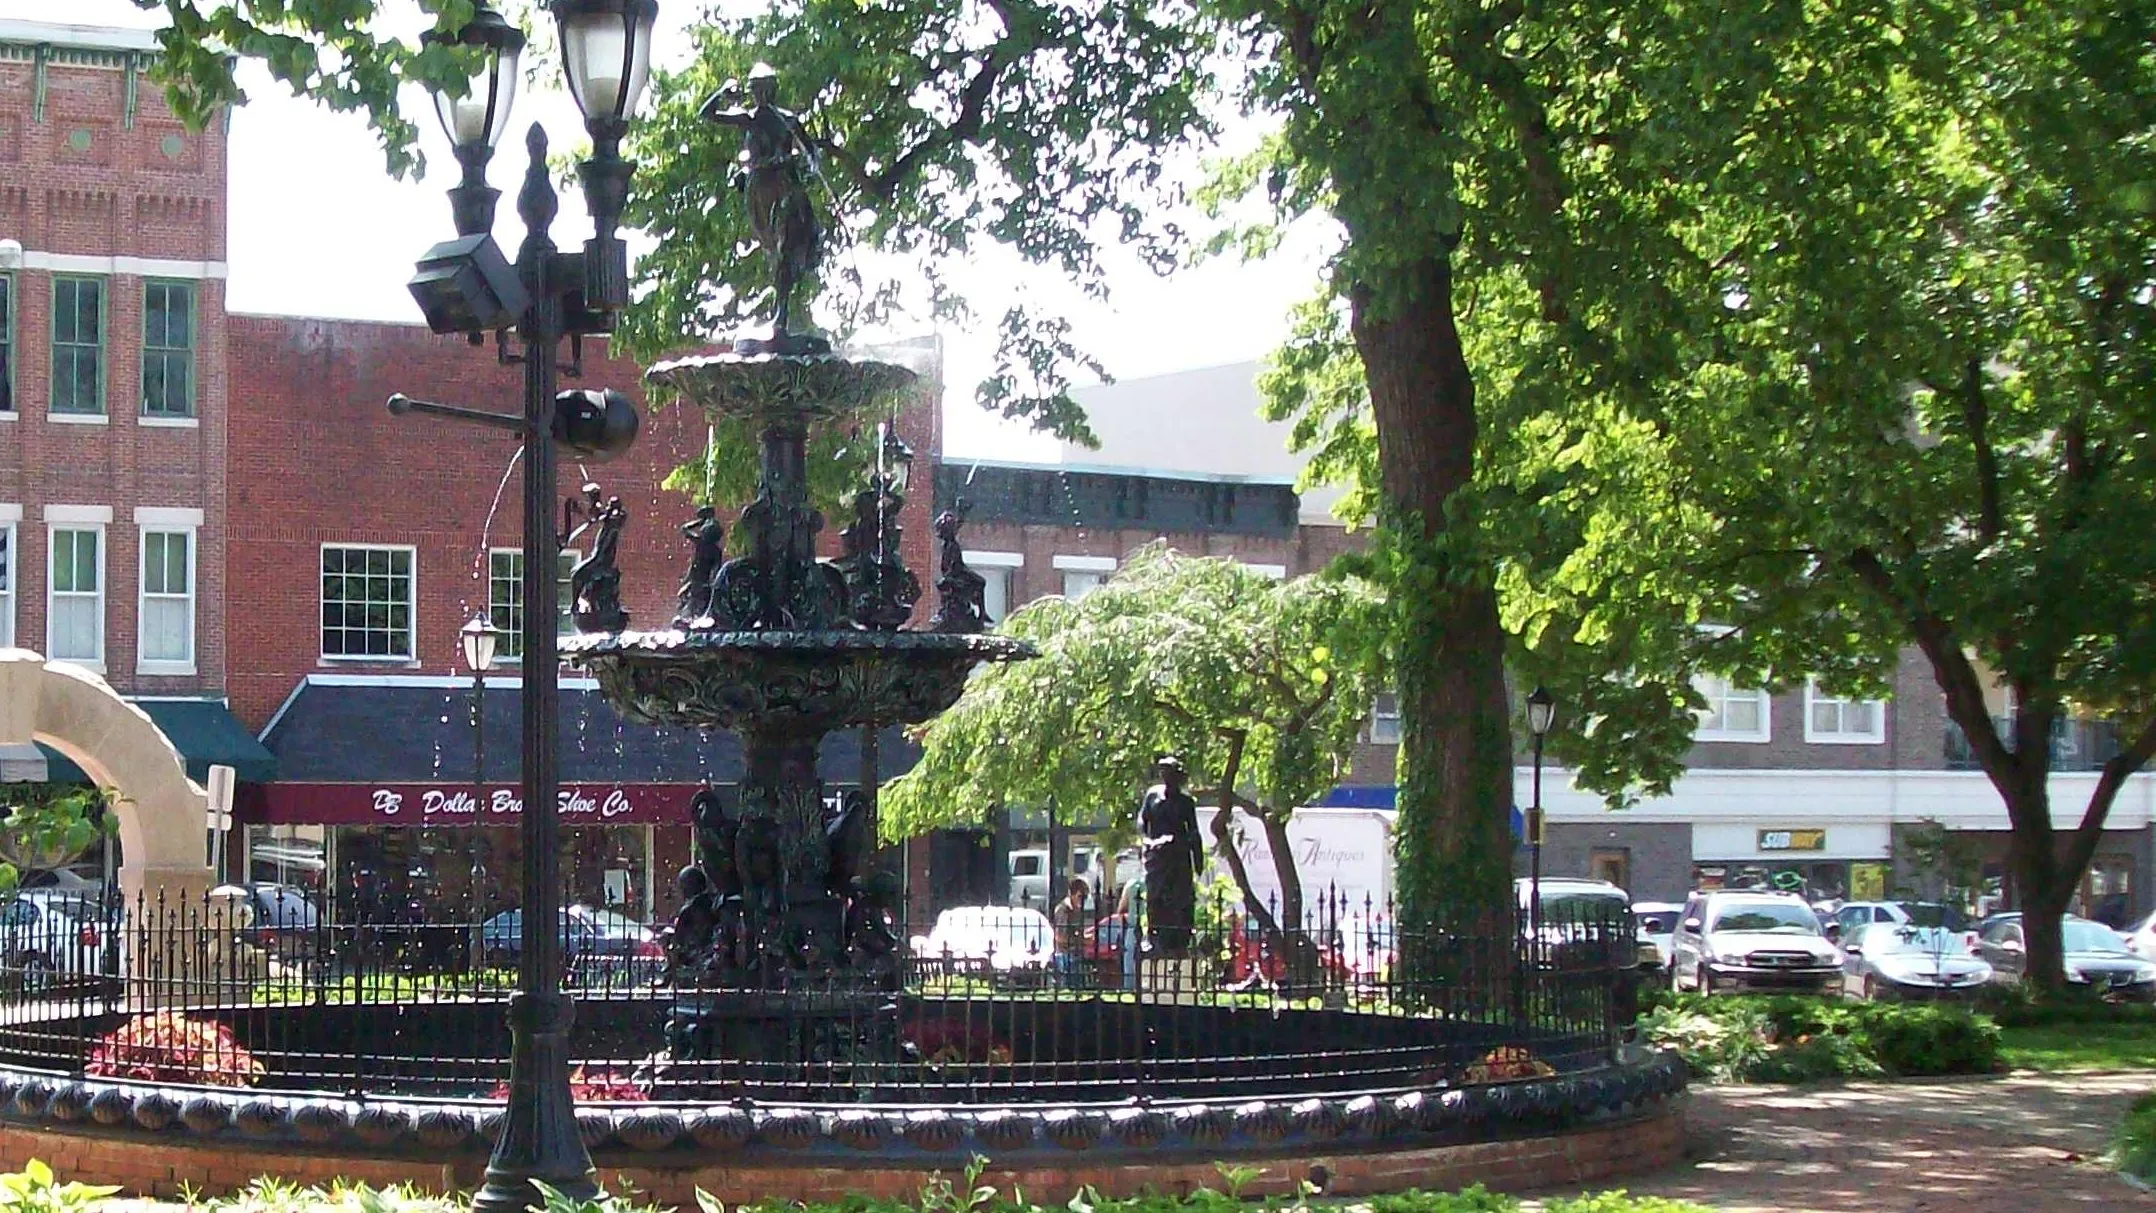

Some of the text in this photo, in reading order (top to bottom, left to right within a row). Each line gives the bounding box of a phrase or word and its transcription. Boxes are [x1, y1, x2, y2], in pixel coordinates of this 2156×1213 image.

[422, 789, 485, 814] Dolla
[557, 788, 596, 814] Shoe
[602, 790, 633, 817] Co.
[1298, 837, 1365, 868] Antiques
